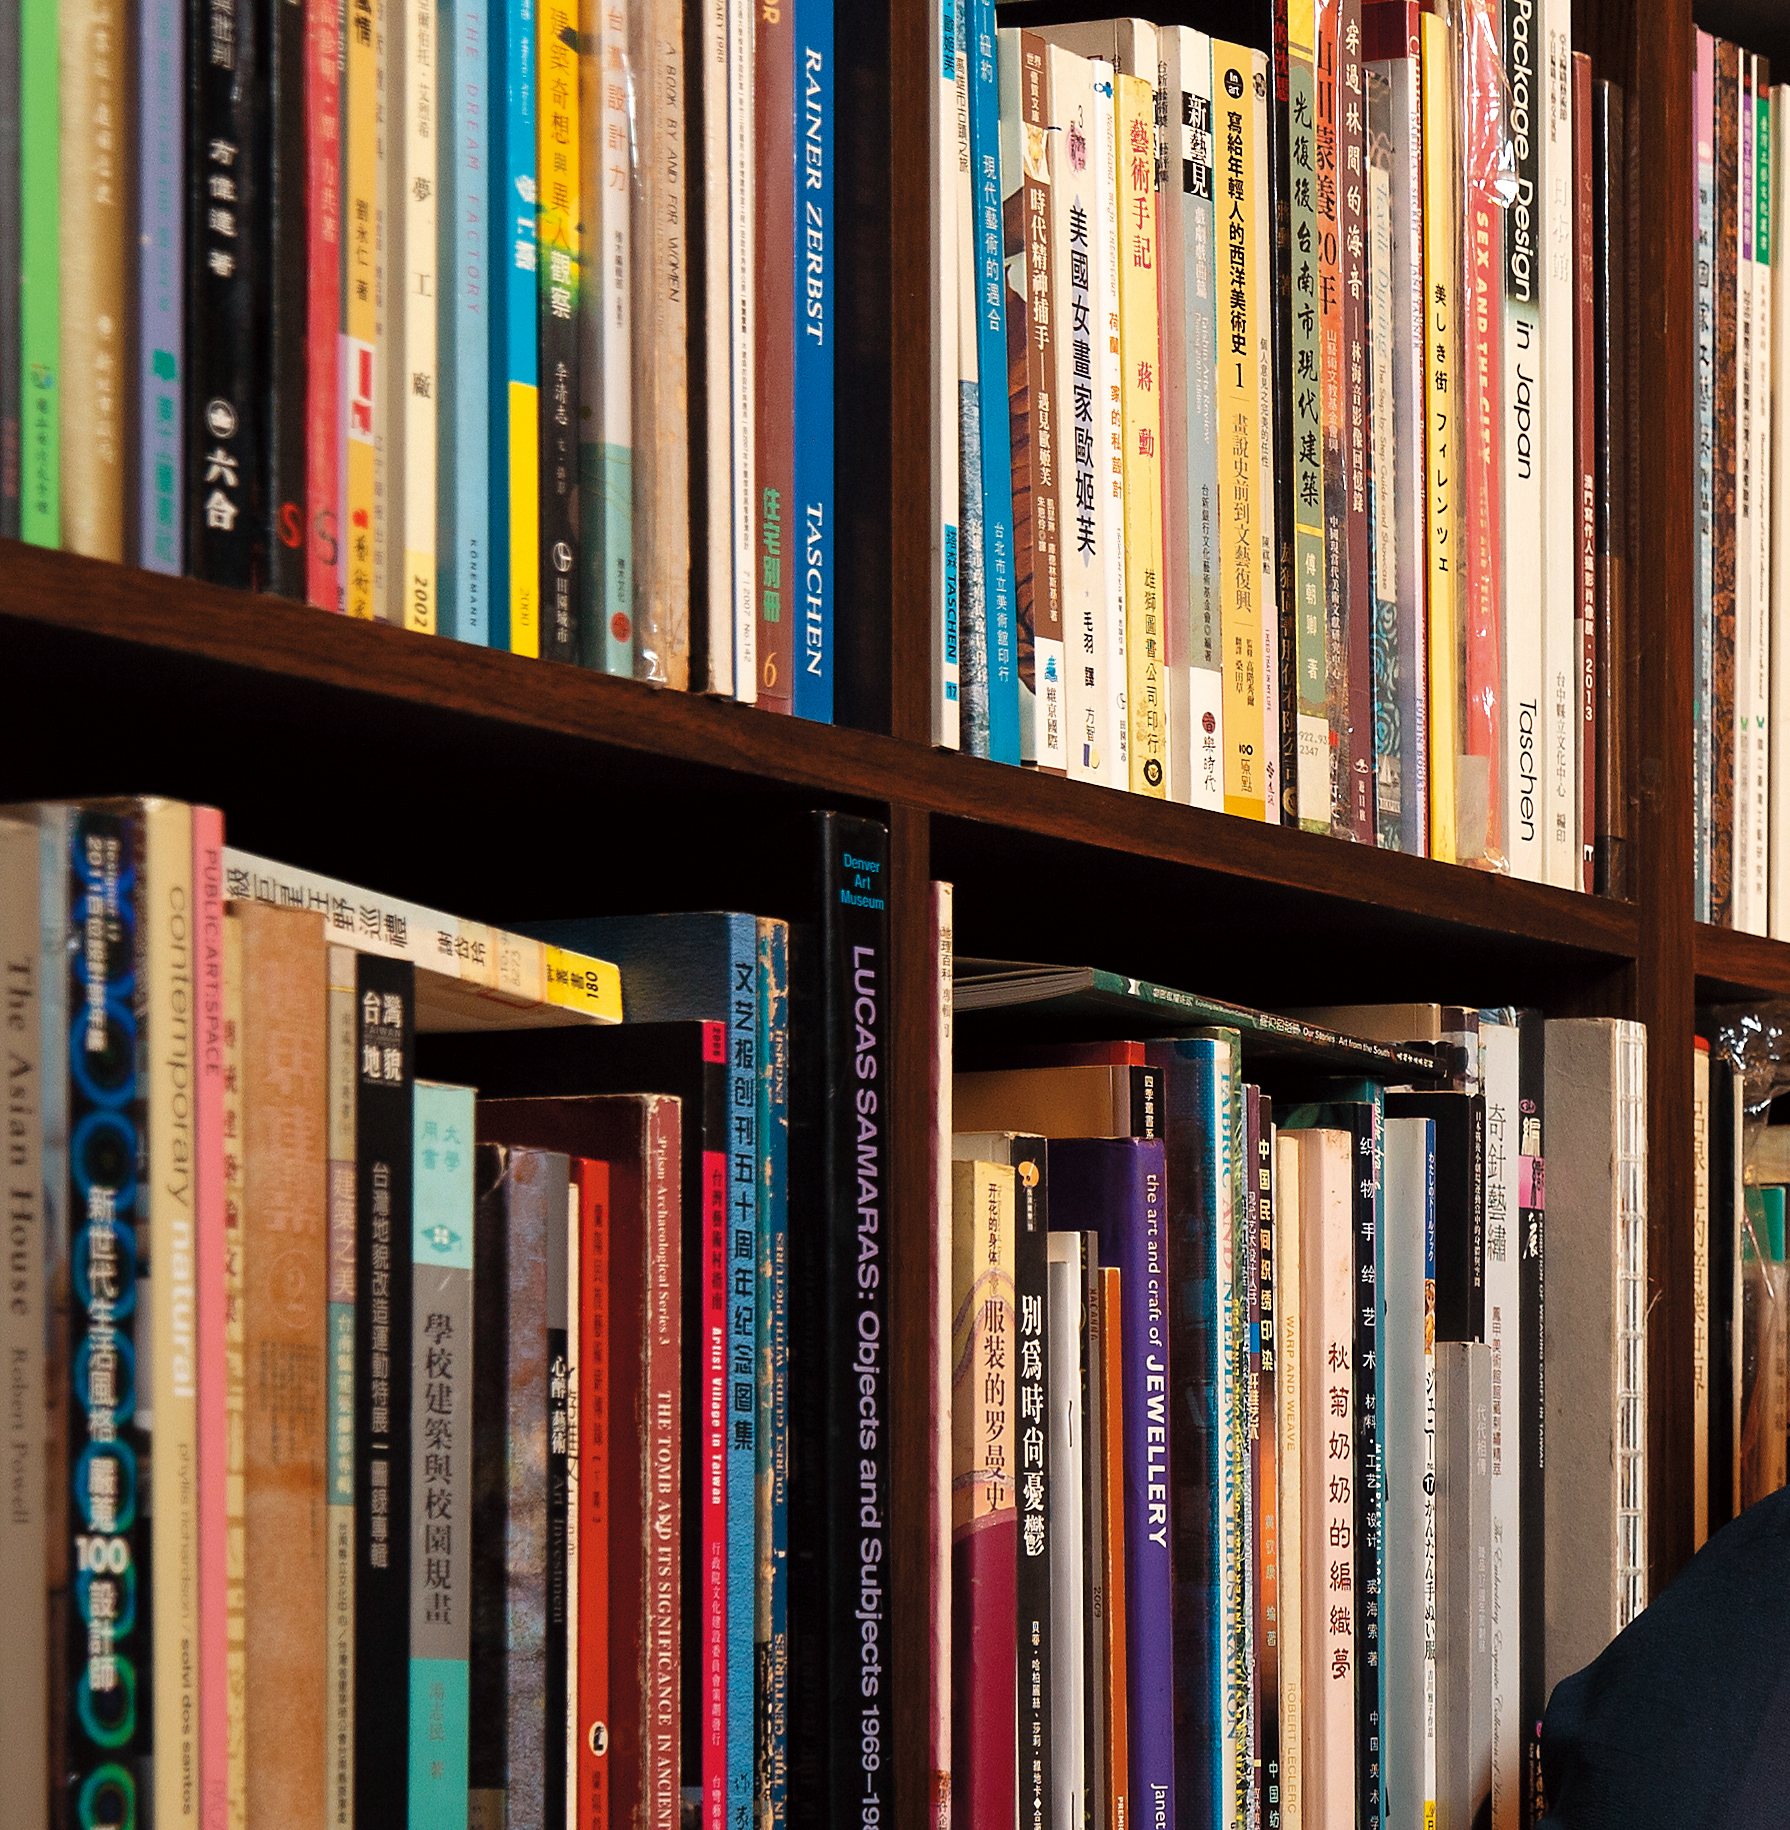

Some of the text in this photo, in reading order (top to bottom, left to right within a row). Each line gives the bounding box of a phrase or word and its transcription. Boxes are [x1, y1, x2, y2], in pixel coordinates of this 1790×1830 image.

[716, 36, 724, 63] 1988
[465, 12, 481, 314] THE DREAM FACTORY
[667, 150, 680, 226] AND FOR
[805, 46, 824, 346] RAINER ZERBST
[1129, 117, 1153, 270] 藝術手記
[1187, 94, 1209, 198] 新藝見
[1225, 111, 1248, 389] 寫給年輕人的西洋美術史 1
[1293, 91, 1319, 508] 光復後台南市現代建築
[1511, 0, 1534, 480] Package Design in Japan
[1068, 204, 1097, 556] 美國女畫家歐姬芙
[1476, 209, 1491, 465] SEX AND THE CITY
[204, 449, 239, 531] 六合
[1433, 283, 1450, 572] 美しき街 フィレンツェ
[1231, 413, 1252, 614] 畫說史前到文藝復興
[413, 574, 428, 628] 2002
[518, 587, 529, 627] 2000
[806, 502, 824, 677] TASCHEN
[947, 577, 958, 699] TASCHEN 17
[1585, 658, 1594, 721] 2013
[1518, 698, 1538, 843] Taschen
[839, 889, 885, 911] Museum
[843, 852, 881, 874] Denver
[854, 874, 871, 892] Art
[1373, 1045, 1391, 1058] South
[8, 956, 34, 1318] The Asian House
[167, 885, 194, 1398] contemporary natural
[1220, 1071, 1233, 1188] FABRIC
[733, 962, 755, 1452] 文艺报创刊五十周年纪念图集
[986, 1183, 999, 1265] 开化的身体
[1222, 1197, 1233, 1271] AND
[74, 1185, 129, 1575] 新世代生活風格 100
[658, 1290, 670, 1335] Series
[852, 944, 883, 1698] LUCAS SAMARAS: Objects and Subjects
[1146, 1173, 1168, 1548] the art and craft JEWELLERY
[657, 1390, 672, 1435] THE
[711, 1326, 722, 1506] Artist Village Taiwan
[983, 1299, 1006, 1513] 服装的罗曼史
[1222, 1280, 1235, 1504] NEEDLEWORK
[1286, 1315, 1296, 1453] WARP AND WEAVE
[1537, 1423, 1545, 1469] TAIWAN
[422, 1312, 454, 1626] 學校建築與校園規畫
[656, 1438, 673, 1495] TOMB
[656, 1500, 673, 1541] AND
[1327, 1341, 1352, 1680] 秋菊奶奶的編織夢
[1423, 1369, 1436, 1660] ジェニー かんたん手ぬい服
[657, 1545, 673, 1576] ITS
[656, 1580, 673, 1727] SIGNIFICANCE
[773, 1632, 786, 1736] CENTURIES
[1150, 1783, 1169, 1830] Janet
[1286, 1682, 1298, 1815] ROBERT LECLERC
